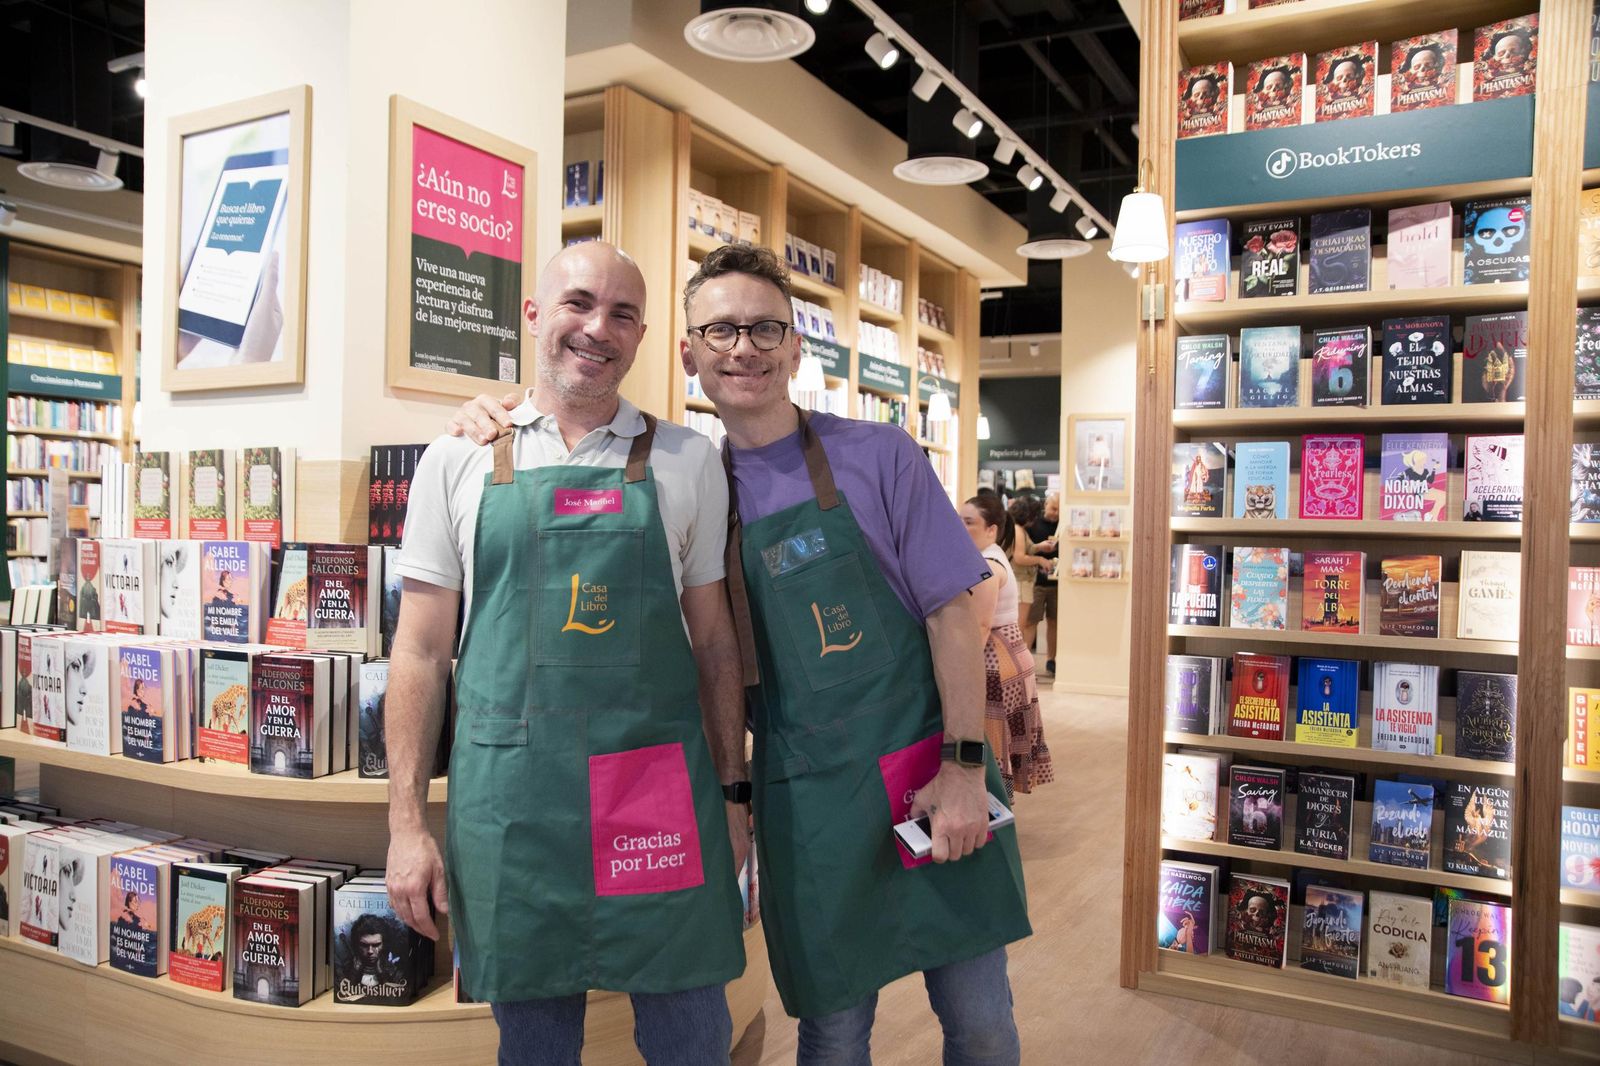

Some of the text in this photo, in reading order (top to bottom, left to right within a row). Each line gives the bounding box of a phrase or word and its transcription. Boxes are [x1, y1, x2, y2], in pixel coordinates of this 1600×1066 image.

[1479, 73, 1536, 96] PHANTASMA
[1396, 86, 1447, 109] PHANTASMA
[1321, 98, 1366, 117] PHANTASMA
[1182, 113, 1222, 131] PHANTASMA
[1250, 106, 1295, 125] PHANTASMA
[1299, 144, 1422, 170] BookTokers
[417, 163, 491, 207] ¿Aún no
[219, 203, 266, 215] Busca el libro
[216, 214, 256, 227] que quieras
[416, 198, 514, 242] eres socio?
[1247, 221, 1295, 233] KATY EVANS
[1178, 232, 1222, 248] NUESTRO
[1314, 235, 1366, 248] CRIATURAS
[1251, 258, 1288, 278] REAL
[1477, 256, 1530, 266] OSCURAS
[415, 257, 486, 286] Vive una nueva
[415, 277, 484, 301] experiencia de
[415, 290, 494, 320] lectura y disfruta
[415, 308, 518, 341] de las mejores ventajas.
[1318, 335, 1341, 344] CHLOE
[1342, 333, 1365, 342] WALSH
[1409, 342, 1421, 352] EL
[1179, 350, 1225, 370] Taming
[1396, 355, 1434, 367] TEJIDO
[30, 373, 104, 390] Crecimiento Personal
[1389, 368, 1442, 381] NUESTRAS
[1395, 383, 1434, 394] ALMAS
[1386, 440, 1444, 450] ELLE KENNEDY
[990, 449, 1019, 459] Papelería
[1024, 449, 1047, 458] Regalo
[1384, 479, 1429, 494] NORMA
[563, 498, 582, 507] José
[1384, 495, 1425, 510] DIXON
[209, 545, 240, 559] ISABEL
[204, 558, 247, 573] ALLENDE
[315, 556, 356, 565] ILDEFONSO
[1315, 556, 1352, 566] SARAH J.
[312, 564, 361, 576] FALCONES
[1320, 566, 1345, 574] MAAS
[104, 574, 141, 591] VICTORIA
[324, 580, 344, 589] EN EL
[581, 582, 608, 594] Casa
[1314, 579, 1351, 591] TORRE
[1383, 569, 1432, 594] Perdiendo
[319, 589, 351, 600] AMOR
[594, 593, 608, 603] del
[328, 600, 341, 608] EN
[341, 601, 349, 609] LA
[580, 601, 608, 612] Libro
[822, 603, 847, 617] Casa
[1318, 602, 1345, 613] ALBA
[314, 608, 356, 621] GUERRA
[837, 610, 849, 622] del
[827, 619, 852, 633] Libro
[122, 652, 152, 668] ISABEL
[120, 665, 159, 682] ALLENDE
[261, 669, 301, 681] ILDEFONSO
[256, 678, 305, 692] FALCONES
[271, 695, 290, 705] EN EL
[1323, 702, 1330, 711] LA
[265, 704, 296, 717] AMOR
[1234, 703, 1281, 723] ASISTENTA
[1375, 708, 1433, 726] LA ASISTENTA
[124, 715, 157, 729] MI NOMBRE
[1232, 719, 1280, 732] FREIDA McFADDEN
[1301, 709, 1351, 729] ASISTENTA
[127, 726, 152, 739] ES EMILIA
[259, 724, 302, 739] GUERRA
[1389, 722, 1417, 734] TE VIGILA
[1576, 694, 1587, 764] BUTTER
[1378, 733, 1430, 745] FREIDA McFADDEN
[1235, 774, 1280, 786] CHLOE WALSH
[1238, 783, 1278, 804] Saving
[1302, 784, 1349, 799] AMANECER
[1457, 784, 1511, 799] EN ALGÚN
[1306, 801, 1343, 815] DIOSES
[1474, 796, 1510, 809] LUGAR
[1375, 804, 1422, 824] Rozando
[1493, 810, 1510, 818] DEL
[1479, 817, 1509, 830] MAR
[1306, 827, 1338, 842] FURIA
[1456, 823, 1509, 840] MÁS AZUL
[613, 831, 682, 852] Gracias
[1299, 839, 1344, 853] K.A. TUCKER
[115, 862, 149, 882] ISABEL
[610, 853, 687, 878] por Leer
[1447, 862, 1480, 873] TJ KLUNE
[23, 871, 59, 897] VICTORIA
[111, 874, 156, 896] ALLENDE
[1160, 881, 1205, 898] CAÍDA
[242, 896, 285, 909] ILDEFONSO
[239, 903, 290, 921] FALCONES
[252, 922, 273, 933] EN EL
[1304, 910, 1347, 932] Jugando
[113, 926, 150, 942] MI NOMBRE
[246, 931, 280, 945] AMOR
[1233, 931, 1278, 949] PHANTASMA
[1325, 925, 1356, 948] fuerte
[1372, 923, 1428, 943] CODICIA
[117, 937, 146, 952] ES EMILIA
[248, 943, 278, 954] Y EN LA
[116, 948, 146, 964] DEL VALLE
[241, 951, 286, 968] GUERRA
[1233, 950, 1276, 966] KAYLIE SMITH
[1455, 935, 1507, 987] 13
[336, 977, 408, 999] Quicksilver
